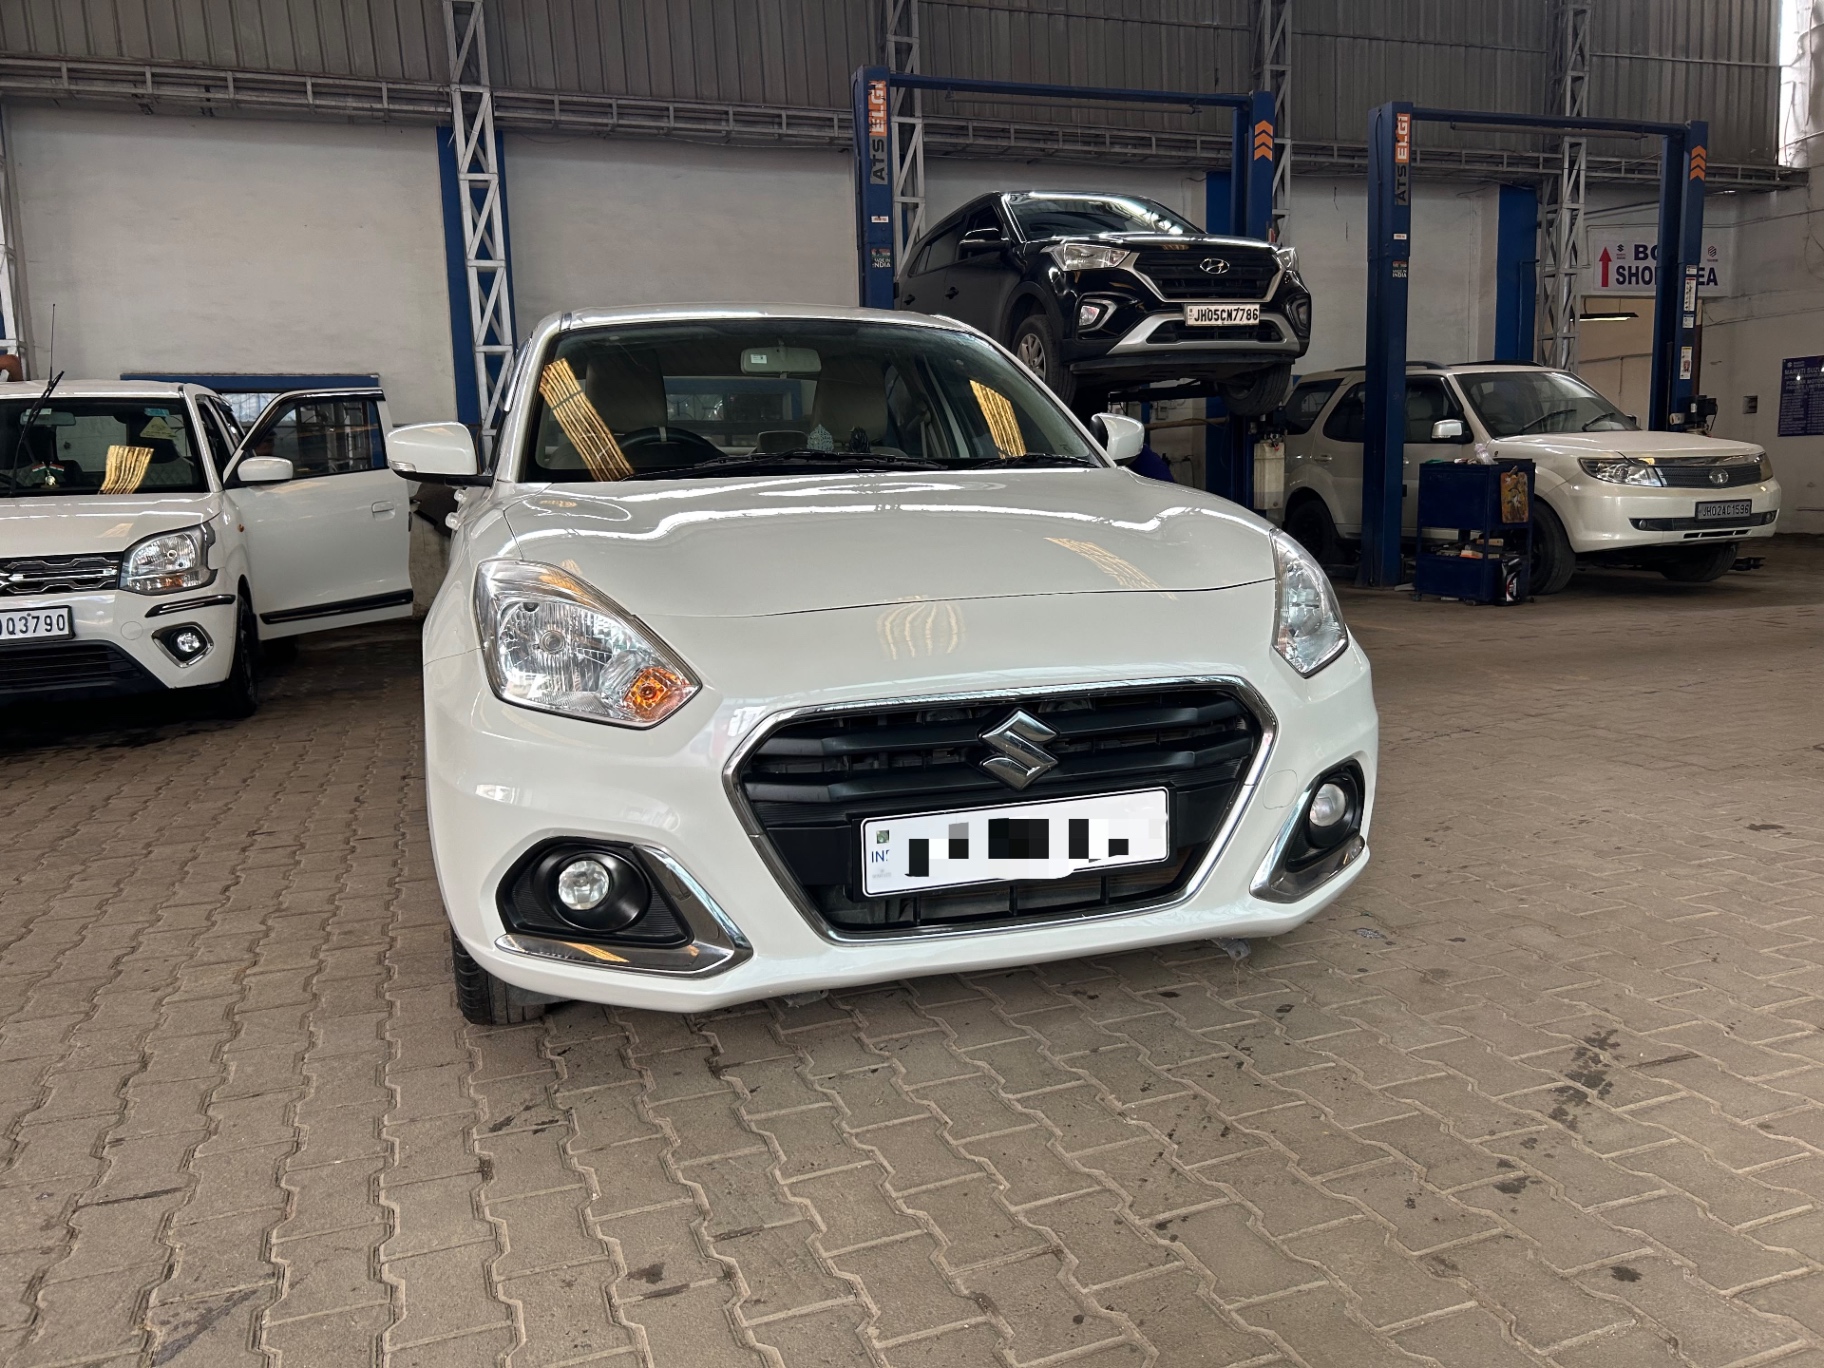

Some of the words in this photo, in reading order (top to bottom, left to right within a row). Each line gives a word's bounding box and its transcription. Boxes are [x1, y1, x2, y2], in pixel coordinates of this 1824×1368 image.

[1397, 116, 1409, 160] ELGI
[872, 139, 886, 181] ATS
[1395, 165, 1408, 202] ATS
[1615, 265, 1658, 286] SHO
[0, 614, 66, 636] Q3790
